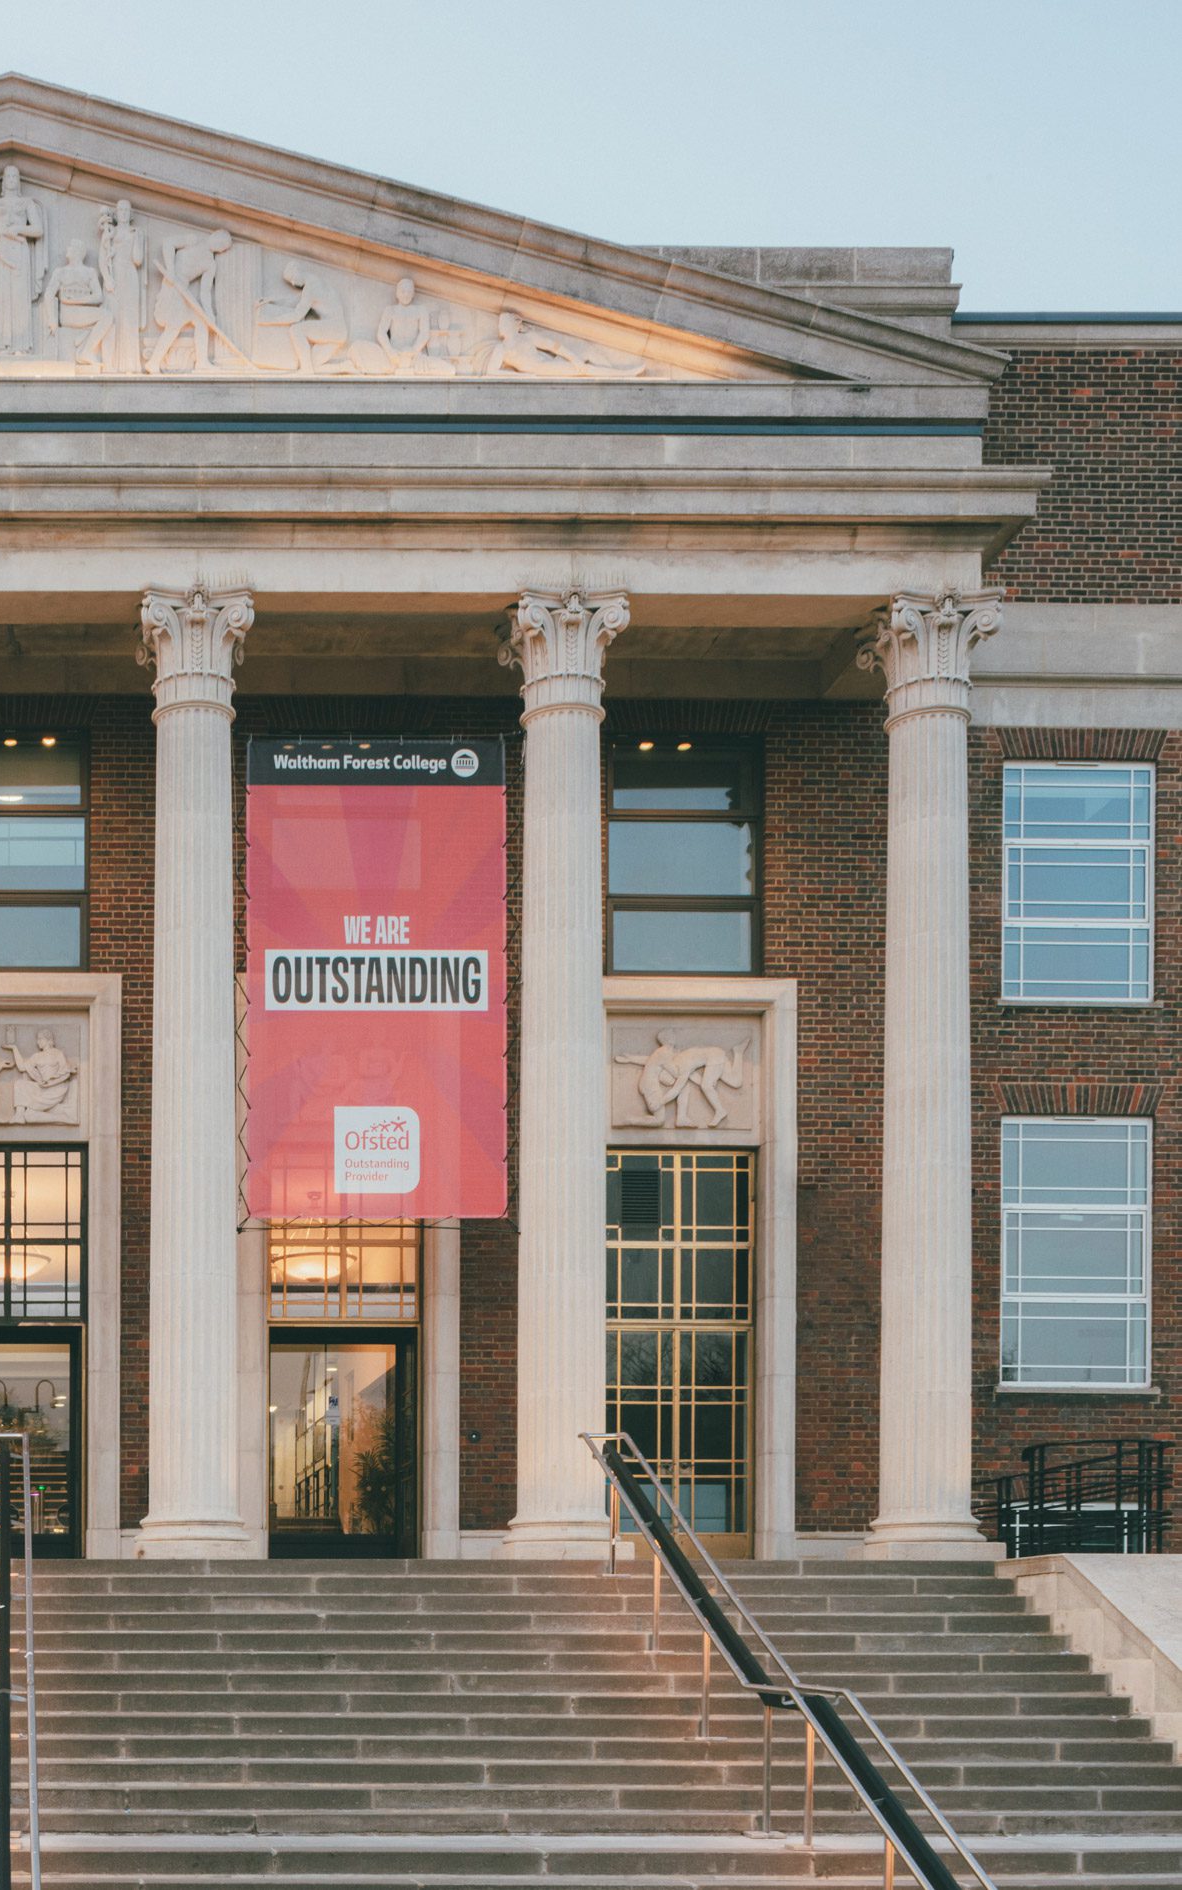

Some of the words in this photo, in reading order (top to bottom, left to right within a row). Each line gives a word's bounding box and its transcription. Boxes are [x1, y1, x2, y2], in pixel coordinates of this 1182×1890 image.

[273, 754, 340, 770] Waltham
[343, 754, 390, 770] Forest
[393, 754, 447, 774] College
[343, 915, 371, 945] WE
[374, 915, 410, 945] ARE
[272, 955, 481, 1005] OUTSTANDING
[344, 1129, 409, 1151] Ofsted
[344, 1158, 410, 1171] Outstanding
[344, 1171, 389, 1182] Provider
